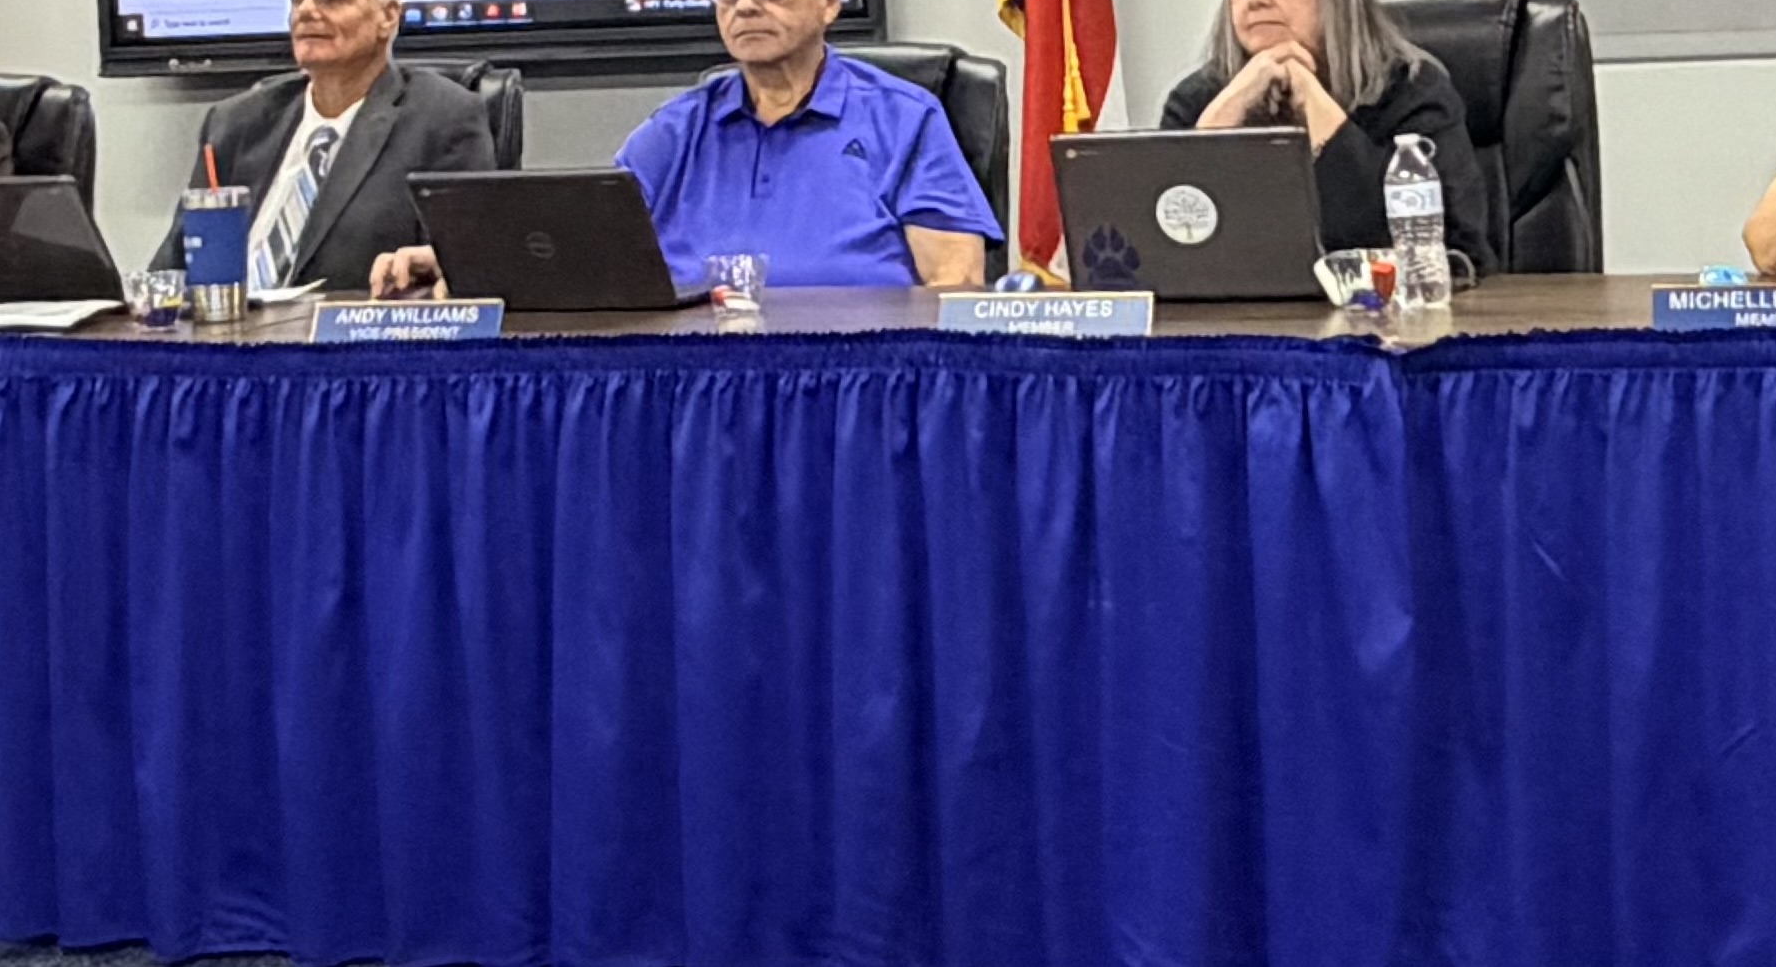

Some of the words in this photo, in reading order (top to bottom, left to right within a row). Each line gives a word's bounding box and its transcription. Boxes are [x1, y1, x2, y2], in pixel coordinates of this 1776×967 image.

[335, 307, 388, 324] ANDY
[391, 306, 479, 324] WILLIAMS
[974, 300, 1039, 318] CINDY
[1045, 300, 1113, 318] HAYES
